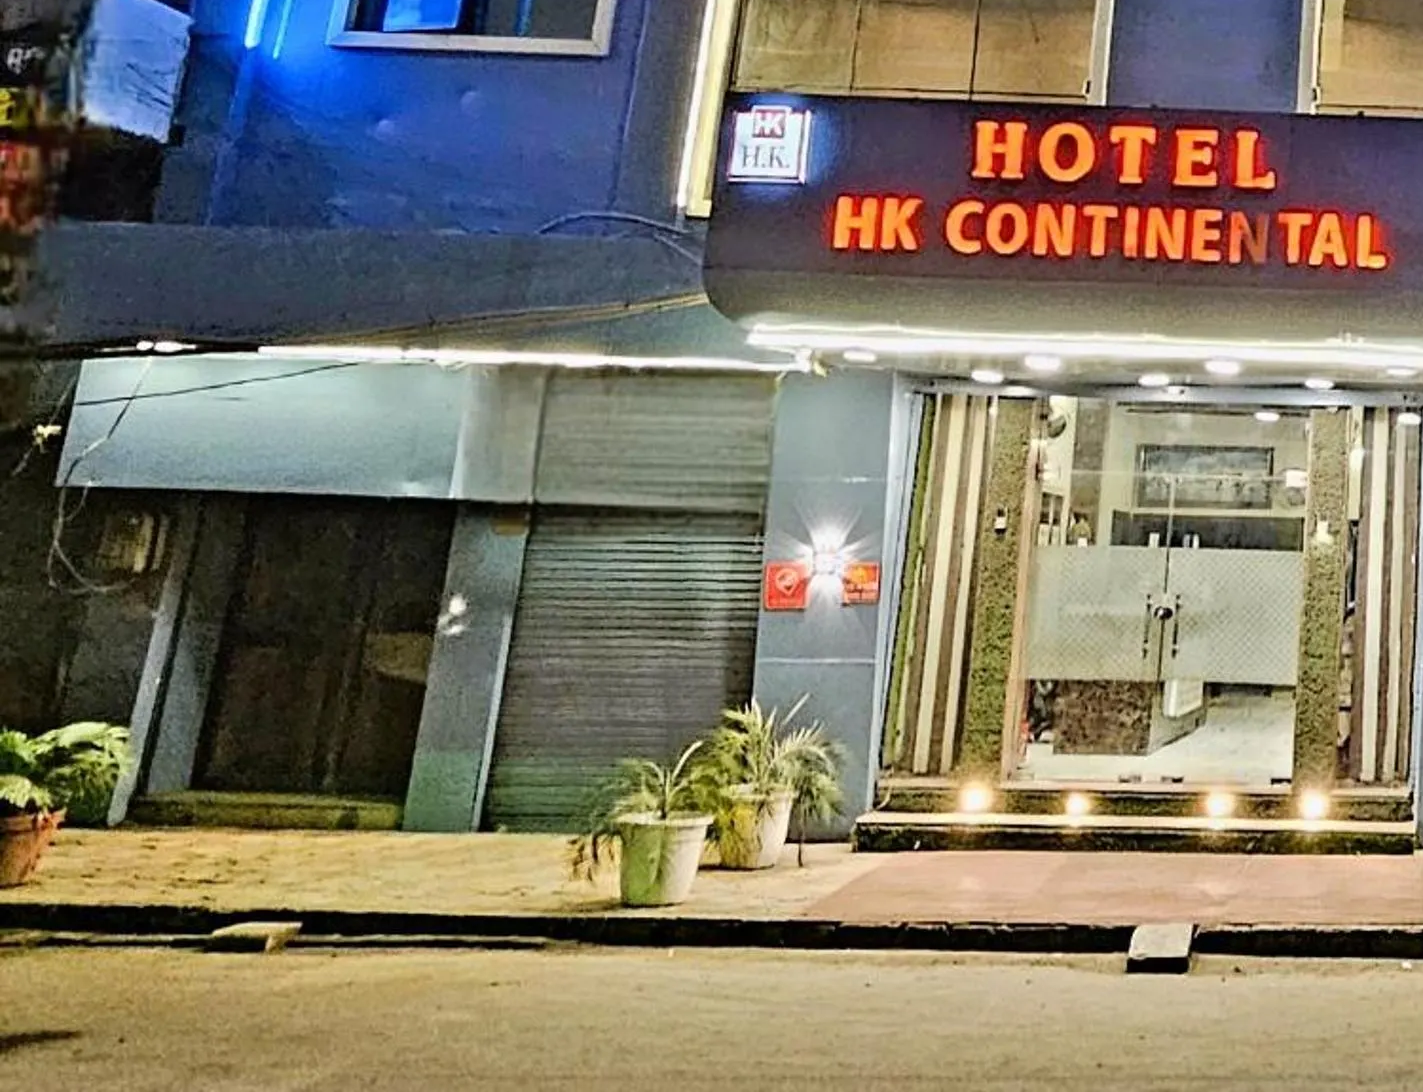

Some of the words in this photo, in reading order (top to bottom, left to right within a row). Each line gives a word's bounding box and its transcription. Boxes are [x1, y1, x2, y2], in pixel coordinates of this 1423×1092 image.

[754, 111, 785, 137] HK
[971, 120, 1277, 190] HOTEL
[833, 195, 924, 251] HK
[945, 199, 1387, 269] CONTINENTAL
